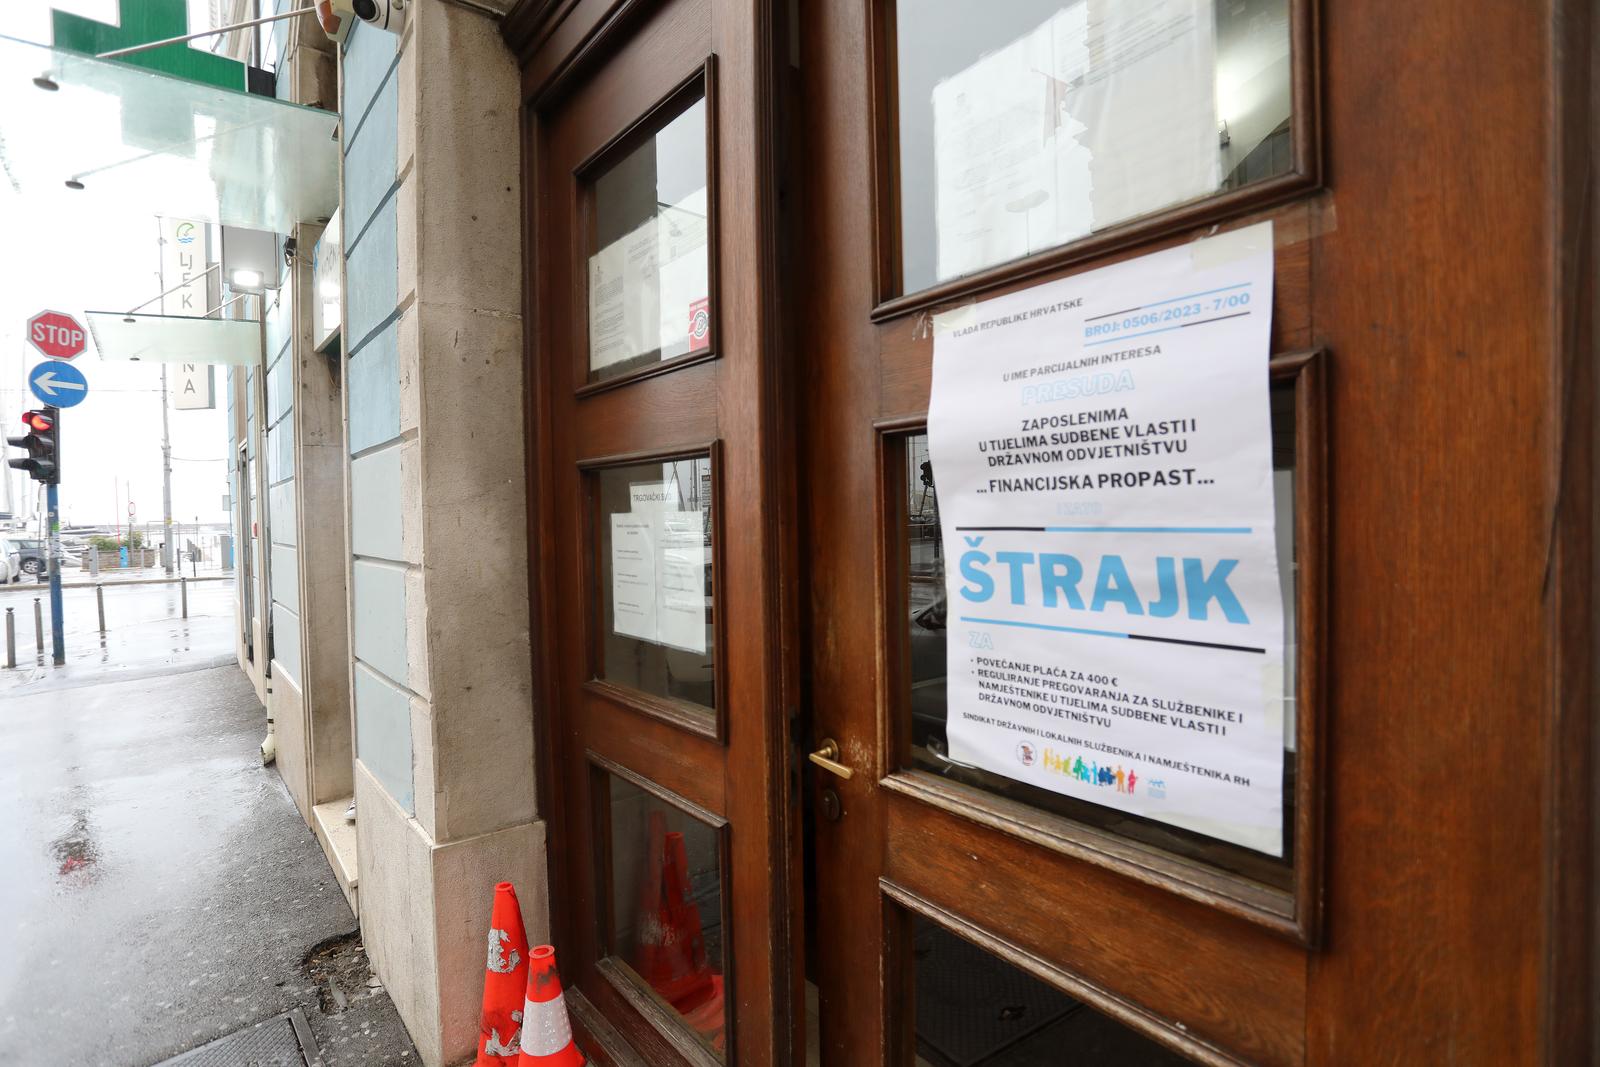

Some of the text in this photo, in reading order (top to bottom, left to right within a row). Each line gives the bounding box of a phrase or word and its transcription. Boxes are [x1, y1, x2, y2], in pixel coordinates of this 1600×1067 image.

[953, 298, 1083, 338] VLADA REPUBLIKE HRVATSKE
[1085, 322, 1120, 338] BROJ:
[1122, 303, 1201, 330] 0506/2023
[1212, 292, 1251, 312] 7/00
[33, 322, 83, 348] STOP
[1003, 344, 1162, 382] U IME PARCIJALNIH INTERESA
[1021, 369, 1136, 405] PRESUDA
[979, 418, 1196, 452] U TIJELIMA SUDBENE VLASTI I
[1021, 408, 1129, 431] ZAPOSLENIMA
[987, 438, 1187, 467] DRŽAVNOM ODVJETNIŠTVU
[1098, 468, 1214, 489] PROPAST...
[959, 536, 1250, 625] ŠTRAJK
[968, 630, 994, 649] ZA
[976, 656, 1119, 687] POVEĆANJE PLAĆA ZA 400 €
[977, 668, 1243, 723] REGULIRANJE PREGOVARANJA ZA SLUŽBENIKE I
[978, 680, 1226, 736] NAMJEŠTENIKE U TIJELIMA SUDBENE VLASTI I
[978, 692, 1112, 729] DRŽAVNOM ODVJETNIŠTVU
[963, 711, 995, 726] SINDIKAT
[996, 719, 1036, 735] DRŽAVNIH
[1040, 730, 1082, 746] LOKALNIH
[1083, 739, 1141, 761] SLUŽBENIKA
[1148, 755, 1231, 783] NAMJEŠTENIKA
[1233, 775, 1251, 788] RH
